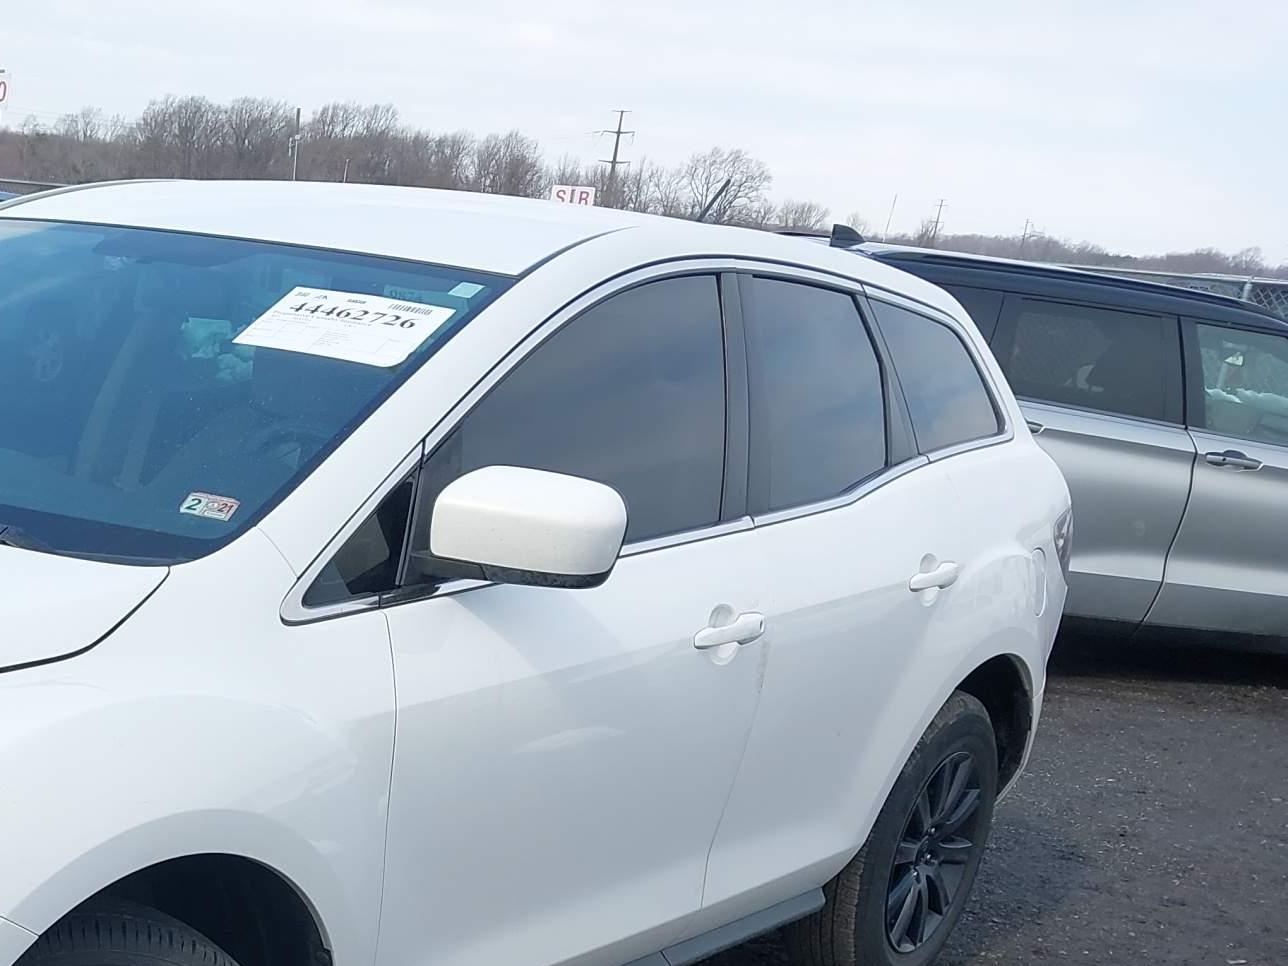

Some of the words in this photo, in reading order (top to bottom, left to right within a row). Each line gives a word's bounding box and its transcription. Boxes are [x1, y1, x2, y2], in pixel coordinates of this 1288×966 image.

[289, 301, 418, 330] 44462726
[184, 498, 202, 511] 2
[217, 503, 233, 513] 21
